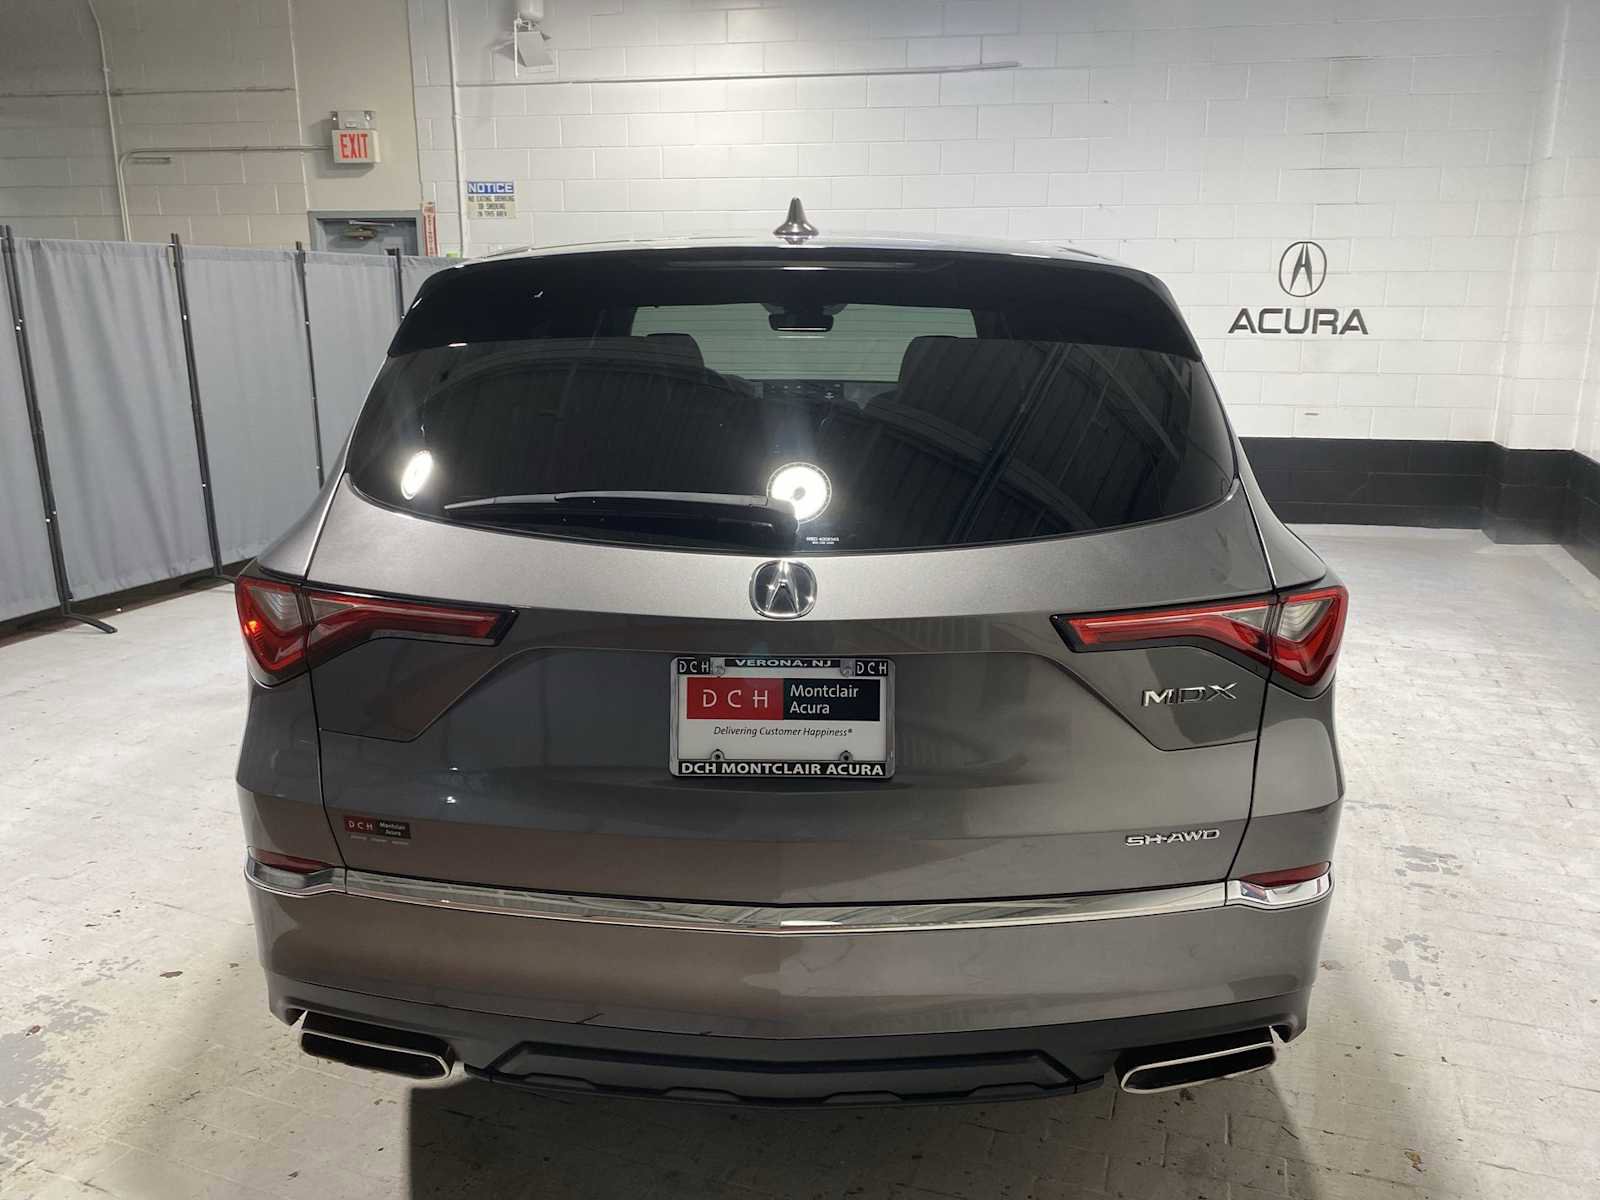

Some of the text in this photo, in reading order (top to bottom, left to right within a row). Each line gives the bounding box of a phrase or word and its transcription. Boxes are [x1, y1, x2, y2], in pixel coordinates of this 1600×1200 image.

[339, 133, 368, 159] EXIT
[468, 183, 513, 193] NOTICE
[1228, 308, 1368, 334] ACURA
[678, 660, 710, 673] DCH
[857, 661, 888, 675] DCH
[789, 684, 859, 698] Montclair
[1142, 681, 1238, 707] MDX
[702, 689, 768, 708] DCH
[789, 701, 830, 714] Acura
[713, 726, 757, 737] Delivering
[760, 727, 801, 737] Customer
[681, 763, 884, 776] DCH MONTCLAIR ACURA
[1125, 829, 1220, 846] SH-AWD
